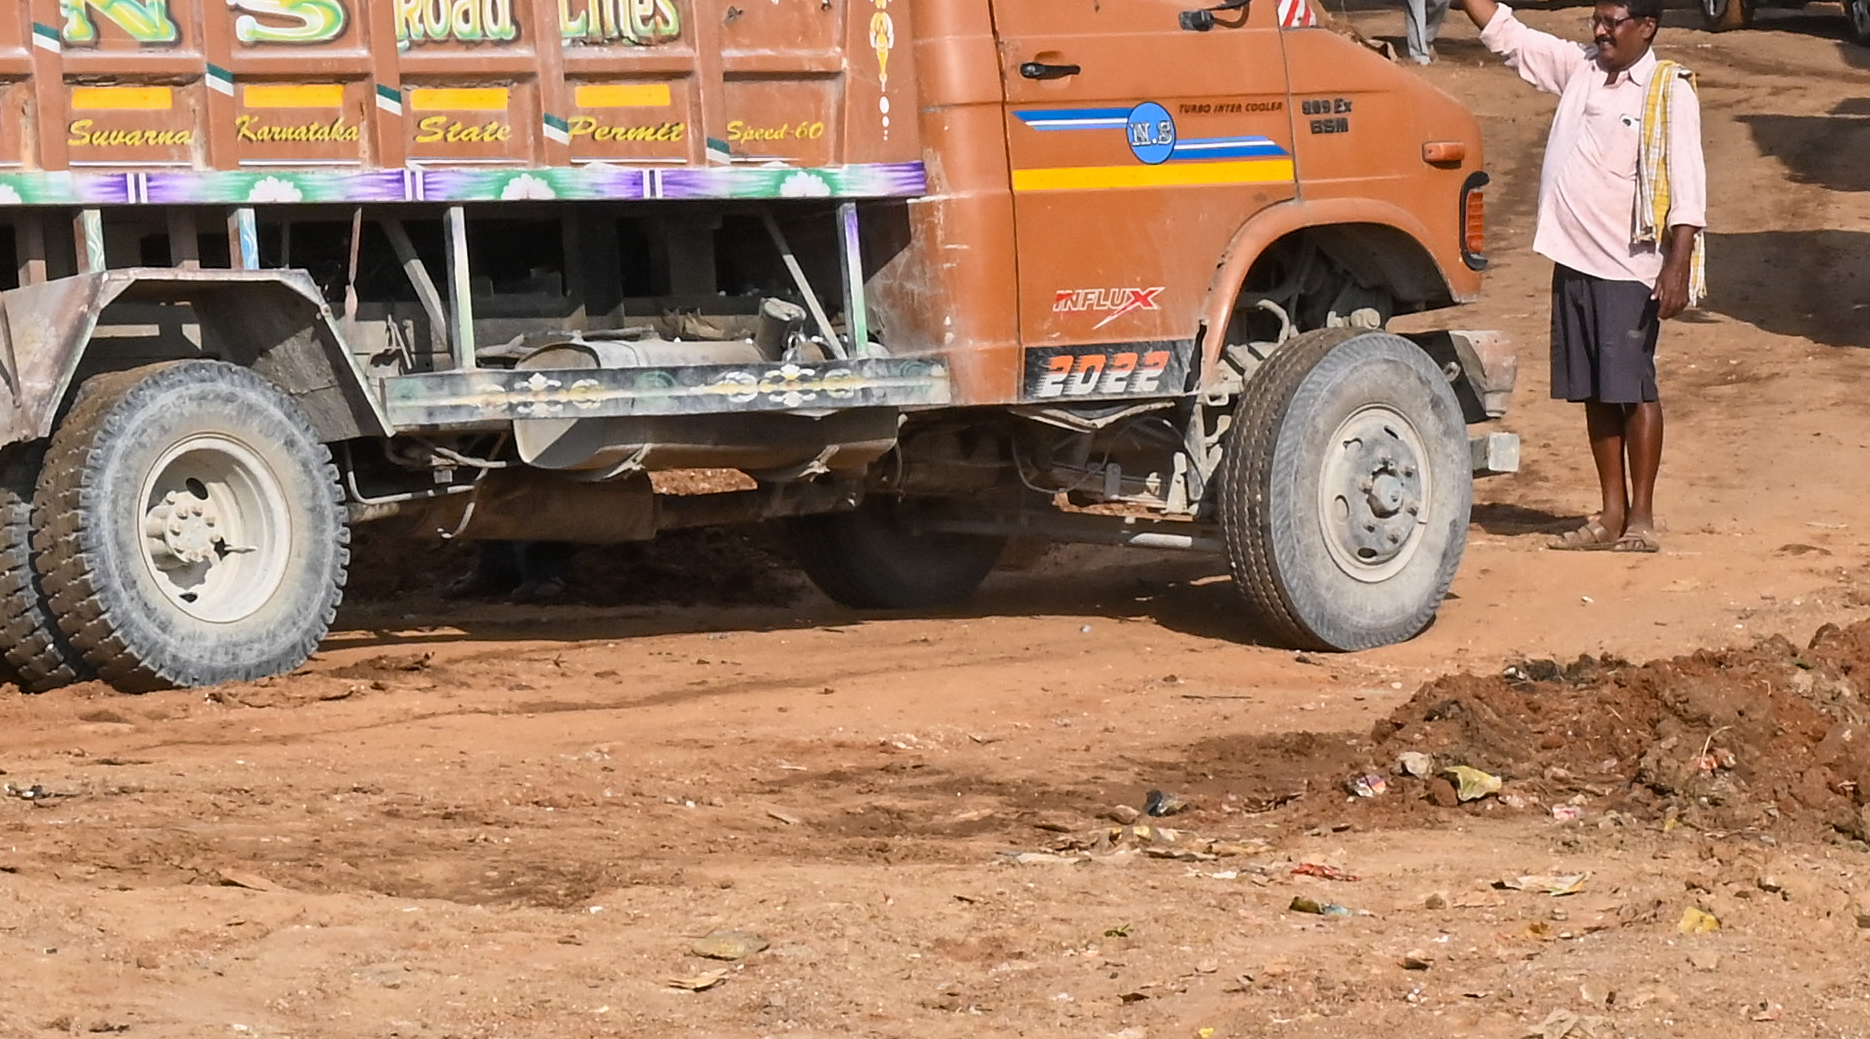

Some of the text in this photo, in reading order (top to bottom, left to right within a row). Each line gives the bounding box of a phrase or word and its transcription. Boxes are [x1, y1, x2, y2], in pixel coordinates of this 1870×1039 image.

[1179, 101, 1283, 114] TURBO INTER COOLER
[68, 114, 685, 147] Suvarna Karnataka State Permit
[1052, 286, 1166, 330] INFLUX
[1035, 350, 1171, 398] 2022
